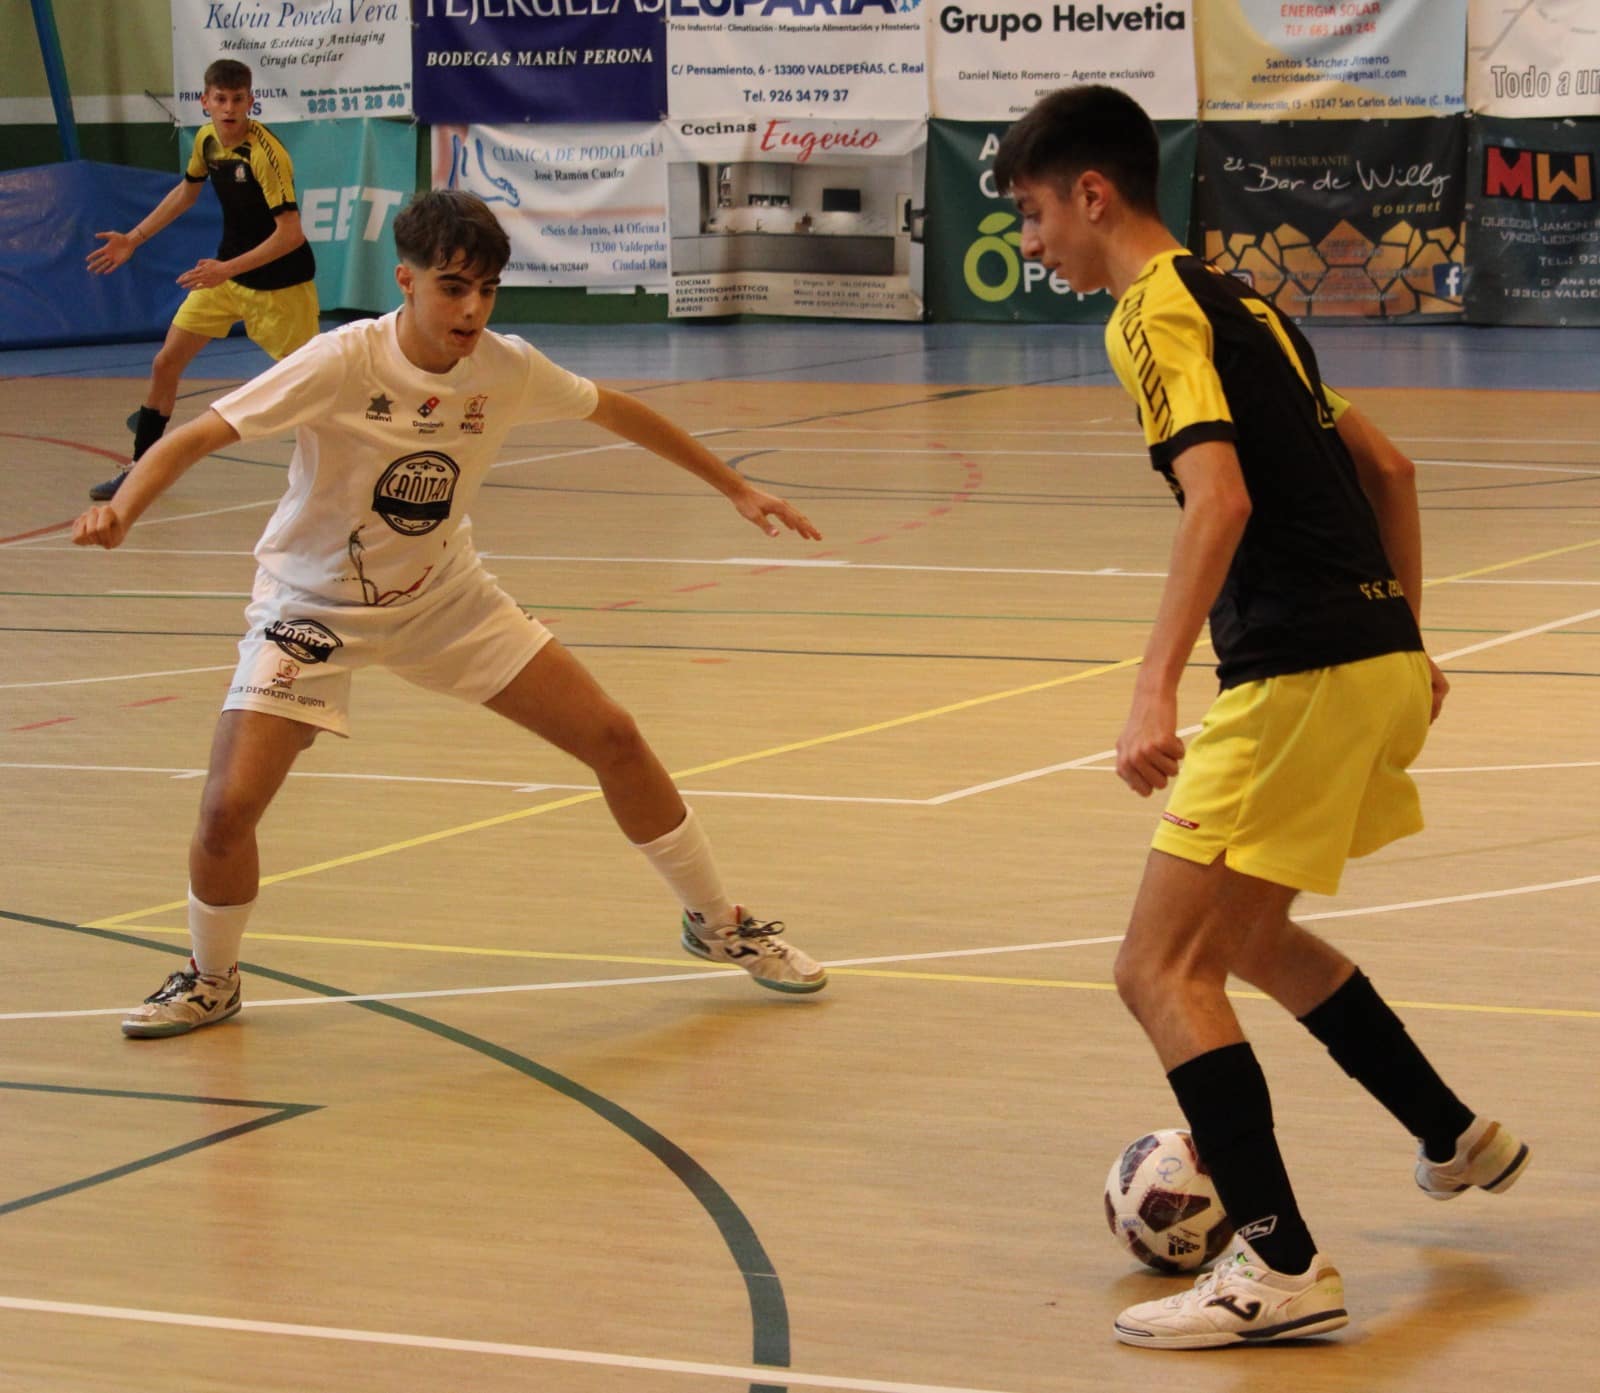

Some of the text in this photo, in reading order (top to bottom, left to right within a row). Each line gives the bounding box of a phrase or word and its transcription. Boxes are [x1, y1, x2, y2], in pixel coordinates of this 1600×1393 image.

[204, 0, 399, 29] Kelvin Poveda Vera
[1340, 2, 1380, 16] SOLAR
[940, 3, 1185, 41] Grupo Helvetia
[219, 31, 386, 51] Medicina Estética y Antiaging
[301, 50, 344, 66] Capilar
[426, 47, 653, 66] BODEGAS MARÍN PERONA
[1265, 55, 1389, 69] Santos Sánchez Jimeno
[671, 64, 683, 76] C/
[686, 64, 756, 76] Pensamiento,
[758, 65, 765, 75] 6
[774, 64, 805, 75] 13300
[889, 63, 898, 73] C.
[901, 62, 924, 73] Real
[958, 70, 989, 80] Daniel
[991, 70, 1018, 80] Nieto
[1021, 70, 1060, 80] Romero
[1071, 70, 1107, 82] Agente
[1109, 69, 1155, 80] exclusivo
[1490, 65, 1551, 98] Todo
[1556, 71, 1571, 96] a
[251, 88, 288, 99] SULTA
[743, 89, 849, 102] Tel. 926 34 79 37
[1339, 98, 1355, 107] San
[1357, 97, 1385, 108] Carlos
[1388, 96, 1401, 106] del
[1404, 95, 1426, 106] Valle
[681, 119, 881, 162] Cocinas Eugenio
[492, 144, 550, 162] CLÍNICA
[555, 148, 575, 161] DE
[1270, 155, 1350, 167] RESTAURANTE
[534, 168, 624, 181] José Ramón Cuadra
[1245, 163, 1305, 192] Bar
[1312, 170, 1351, 191] de
[1486, 147, 1592, 201] MW
[1372, 200, 1441, 218] gourmet
[567, 224, 578, 235] de
[582, 224, 610, 236] Junio,
[626, 222, 656, 234] Oficina
[612, 259, 667, 271] Ciudad Rea
[675, 279, 711, 287] COCINAS
[1560, 278, 1585, 286] ANA
[1504, 288, 1600, 298] 13300 VALDE
[245, 686, 295, 702] DEPORTIVO
